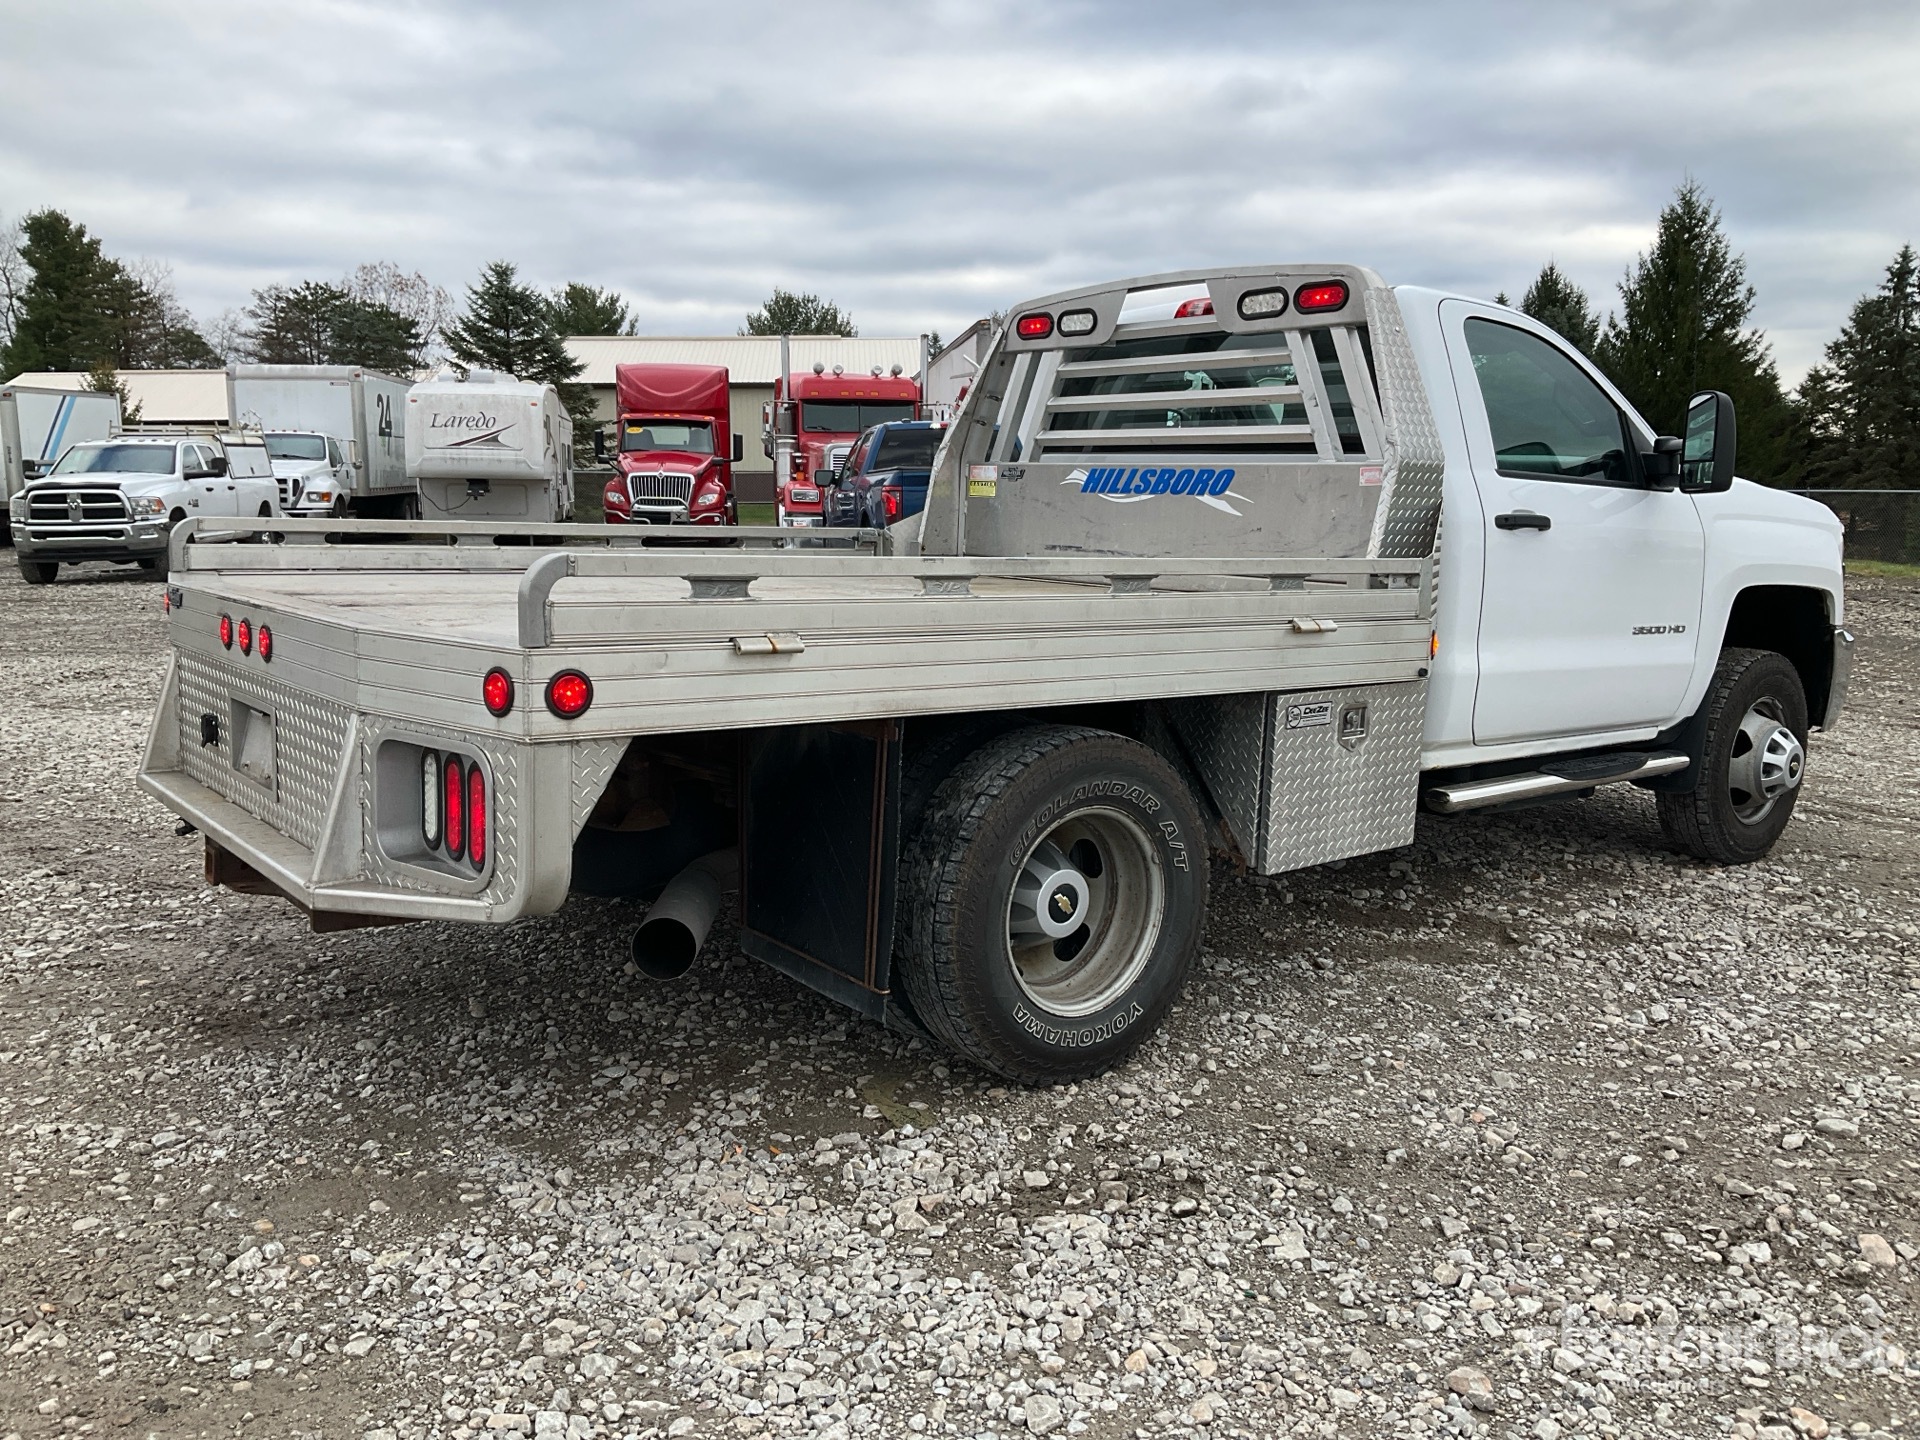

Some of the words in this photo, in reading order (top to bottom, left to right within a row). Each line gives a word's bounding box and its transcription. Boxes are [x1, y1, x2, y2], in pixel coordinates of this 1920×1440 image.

[376, 393, 393, 437] 24
[429, 411, 497, 429] Laredo
[1080, 467, 1236, 497] HILLSBORO
[1632, 625, 1667, 635] 3500
[1667, 624, 1686, 634] HD
[1009, 779, 1161, 867] GEOLANDAR
[1159, 819, 1190, 872] A/T
[1011, 1001, 1144, 1048] YOKOHAMA
